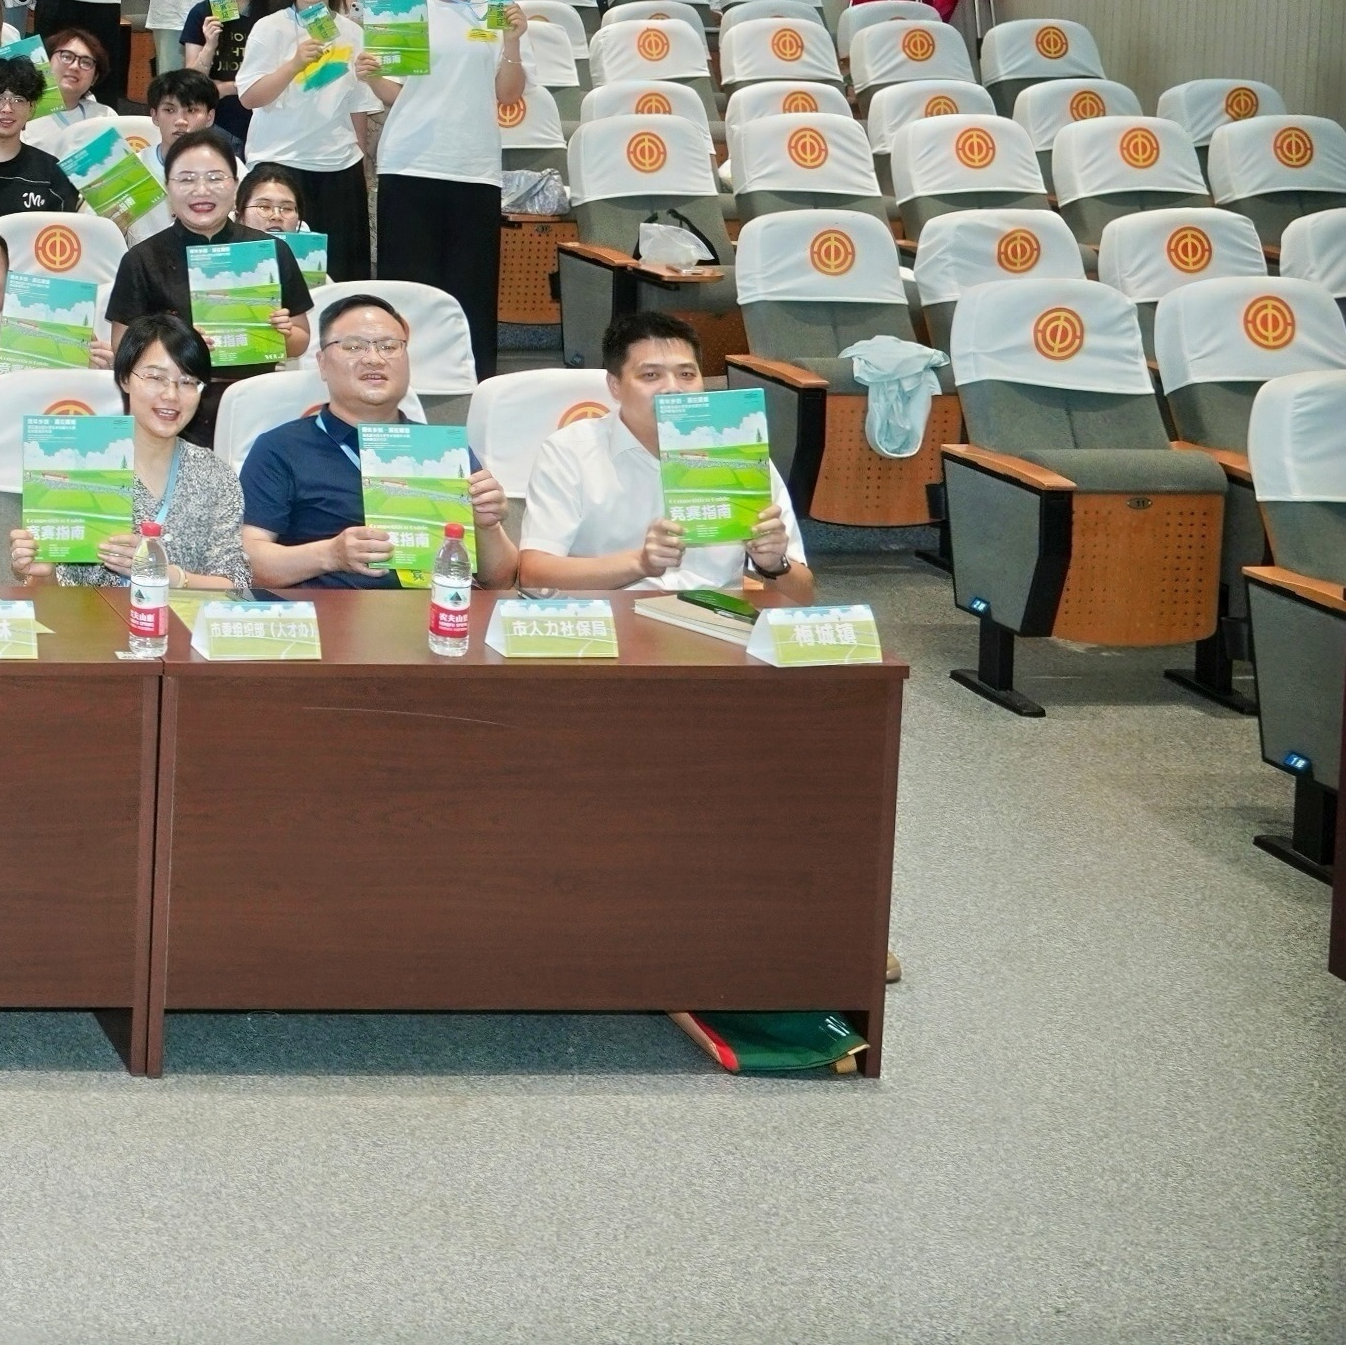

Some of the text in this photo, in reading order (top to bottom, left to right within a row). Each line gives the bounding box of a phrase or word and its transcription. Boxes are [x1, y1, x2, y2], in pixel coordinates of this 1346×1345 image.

[211, 334, 249, 349] 赛指南
[669, 504, 732, 521] 竞赛指南
[27, 526, 86, 541] 竞赛指南
[388, 531, 430, 548] 赛指南
[411, 569, 425, 582] 宾
[130, 609, 156, 624] 夫山泉
[511, 619, 609, 638] 市人力社保局
[794, 623, 858, 648] 梅城镇
